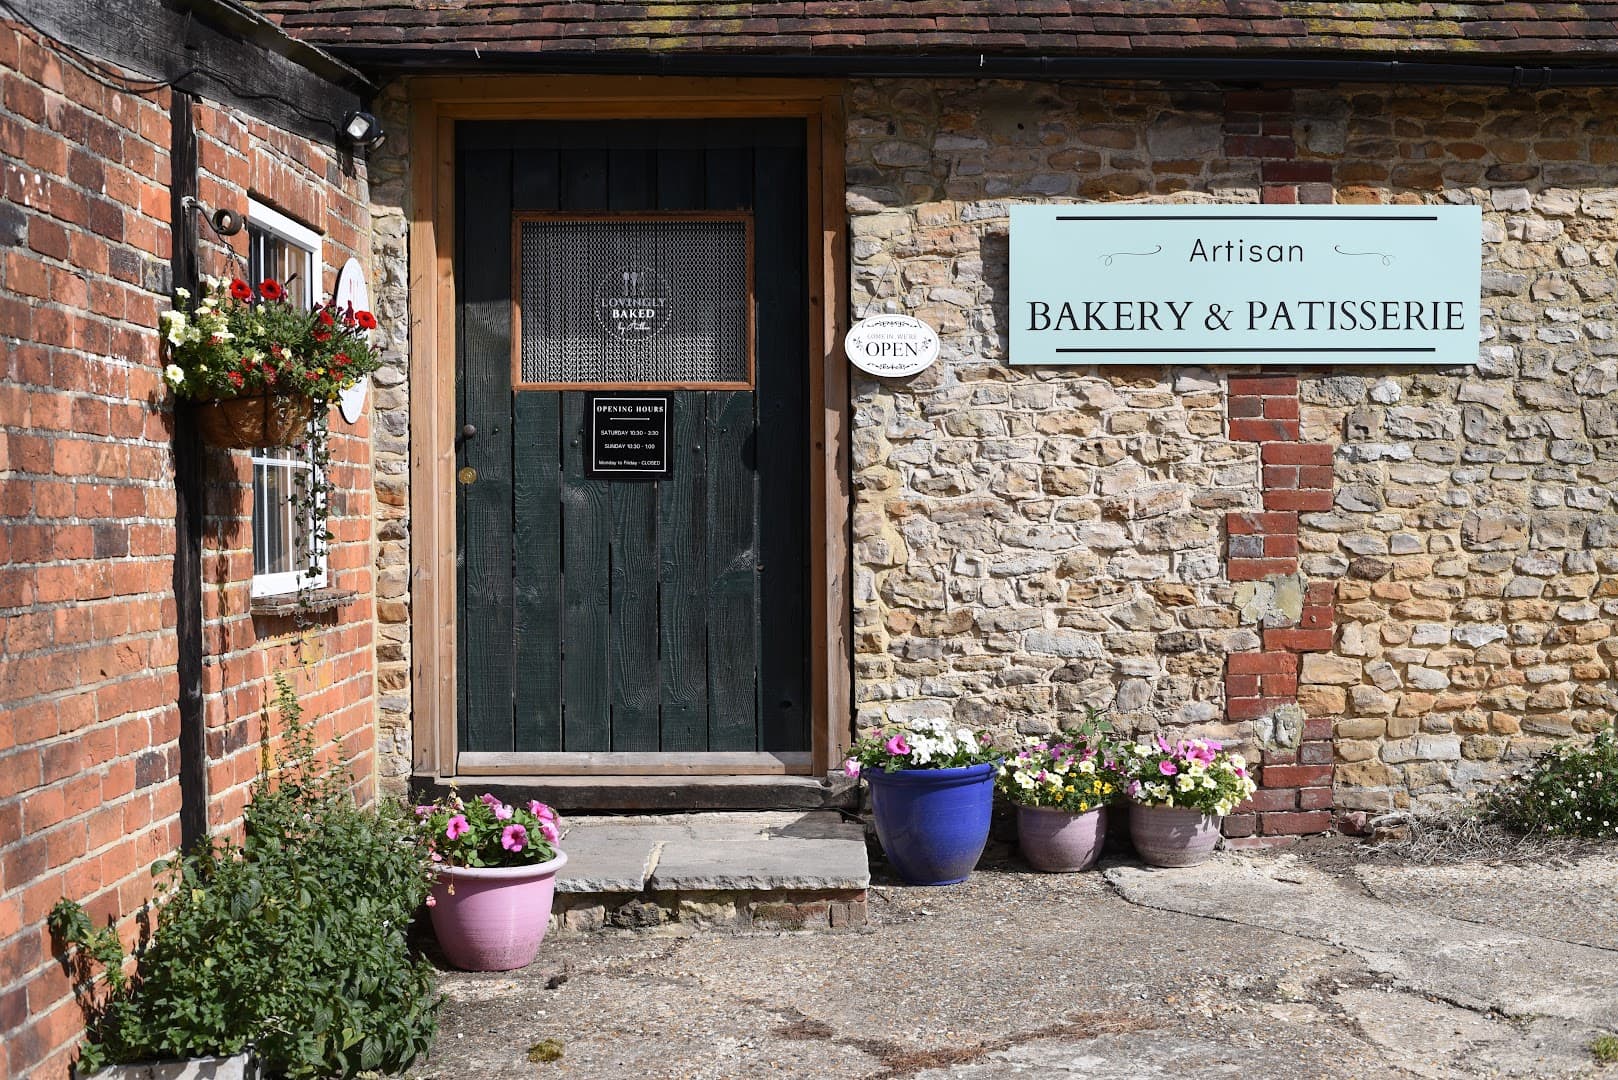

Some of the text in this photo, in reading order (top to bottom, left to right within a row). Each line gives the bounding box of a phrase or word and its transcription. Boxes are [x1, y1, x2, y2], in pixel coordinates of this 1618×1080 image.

[1190, 238, 1304, 263] Artisan
[601, 297, 667, 307] LOVINGLY
[612, 309, 655, 318] BAKED
[1026, 301, 1465, 331] BAKERY & PATISSERIE
[865, 342, 918, 357] OPEN
[596, 405, 664, 413] OPENING HOURS
